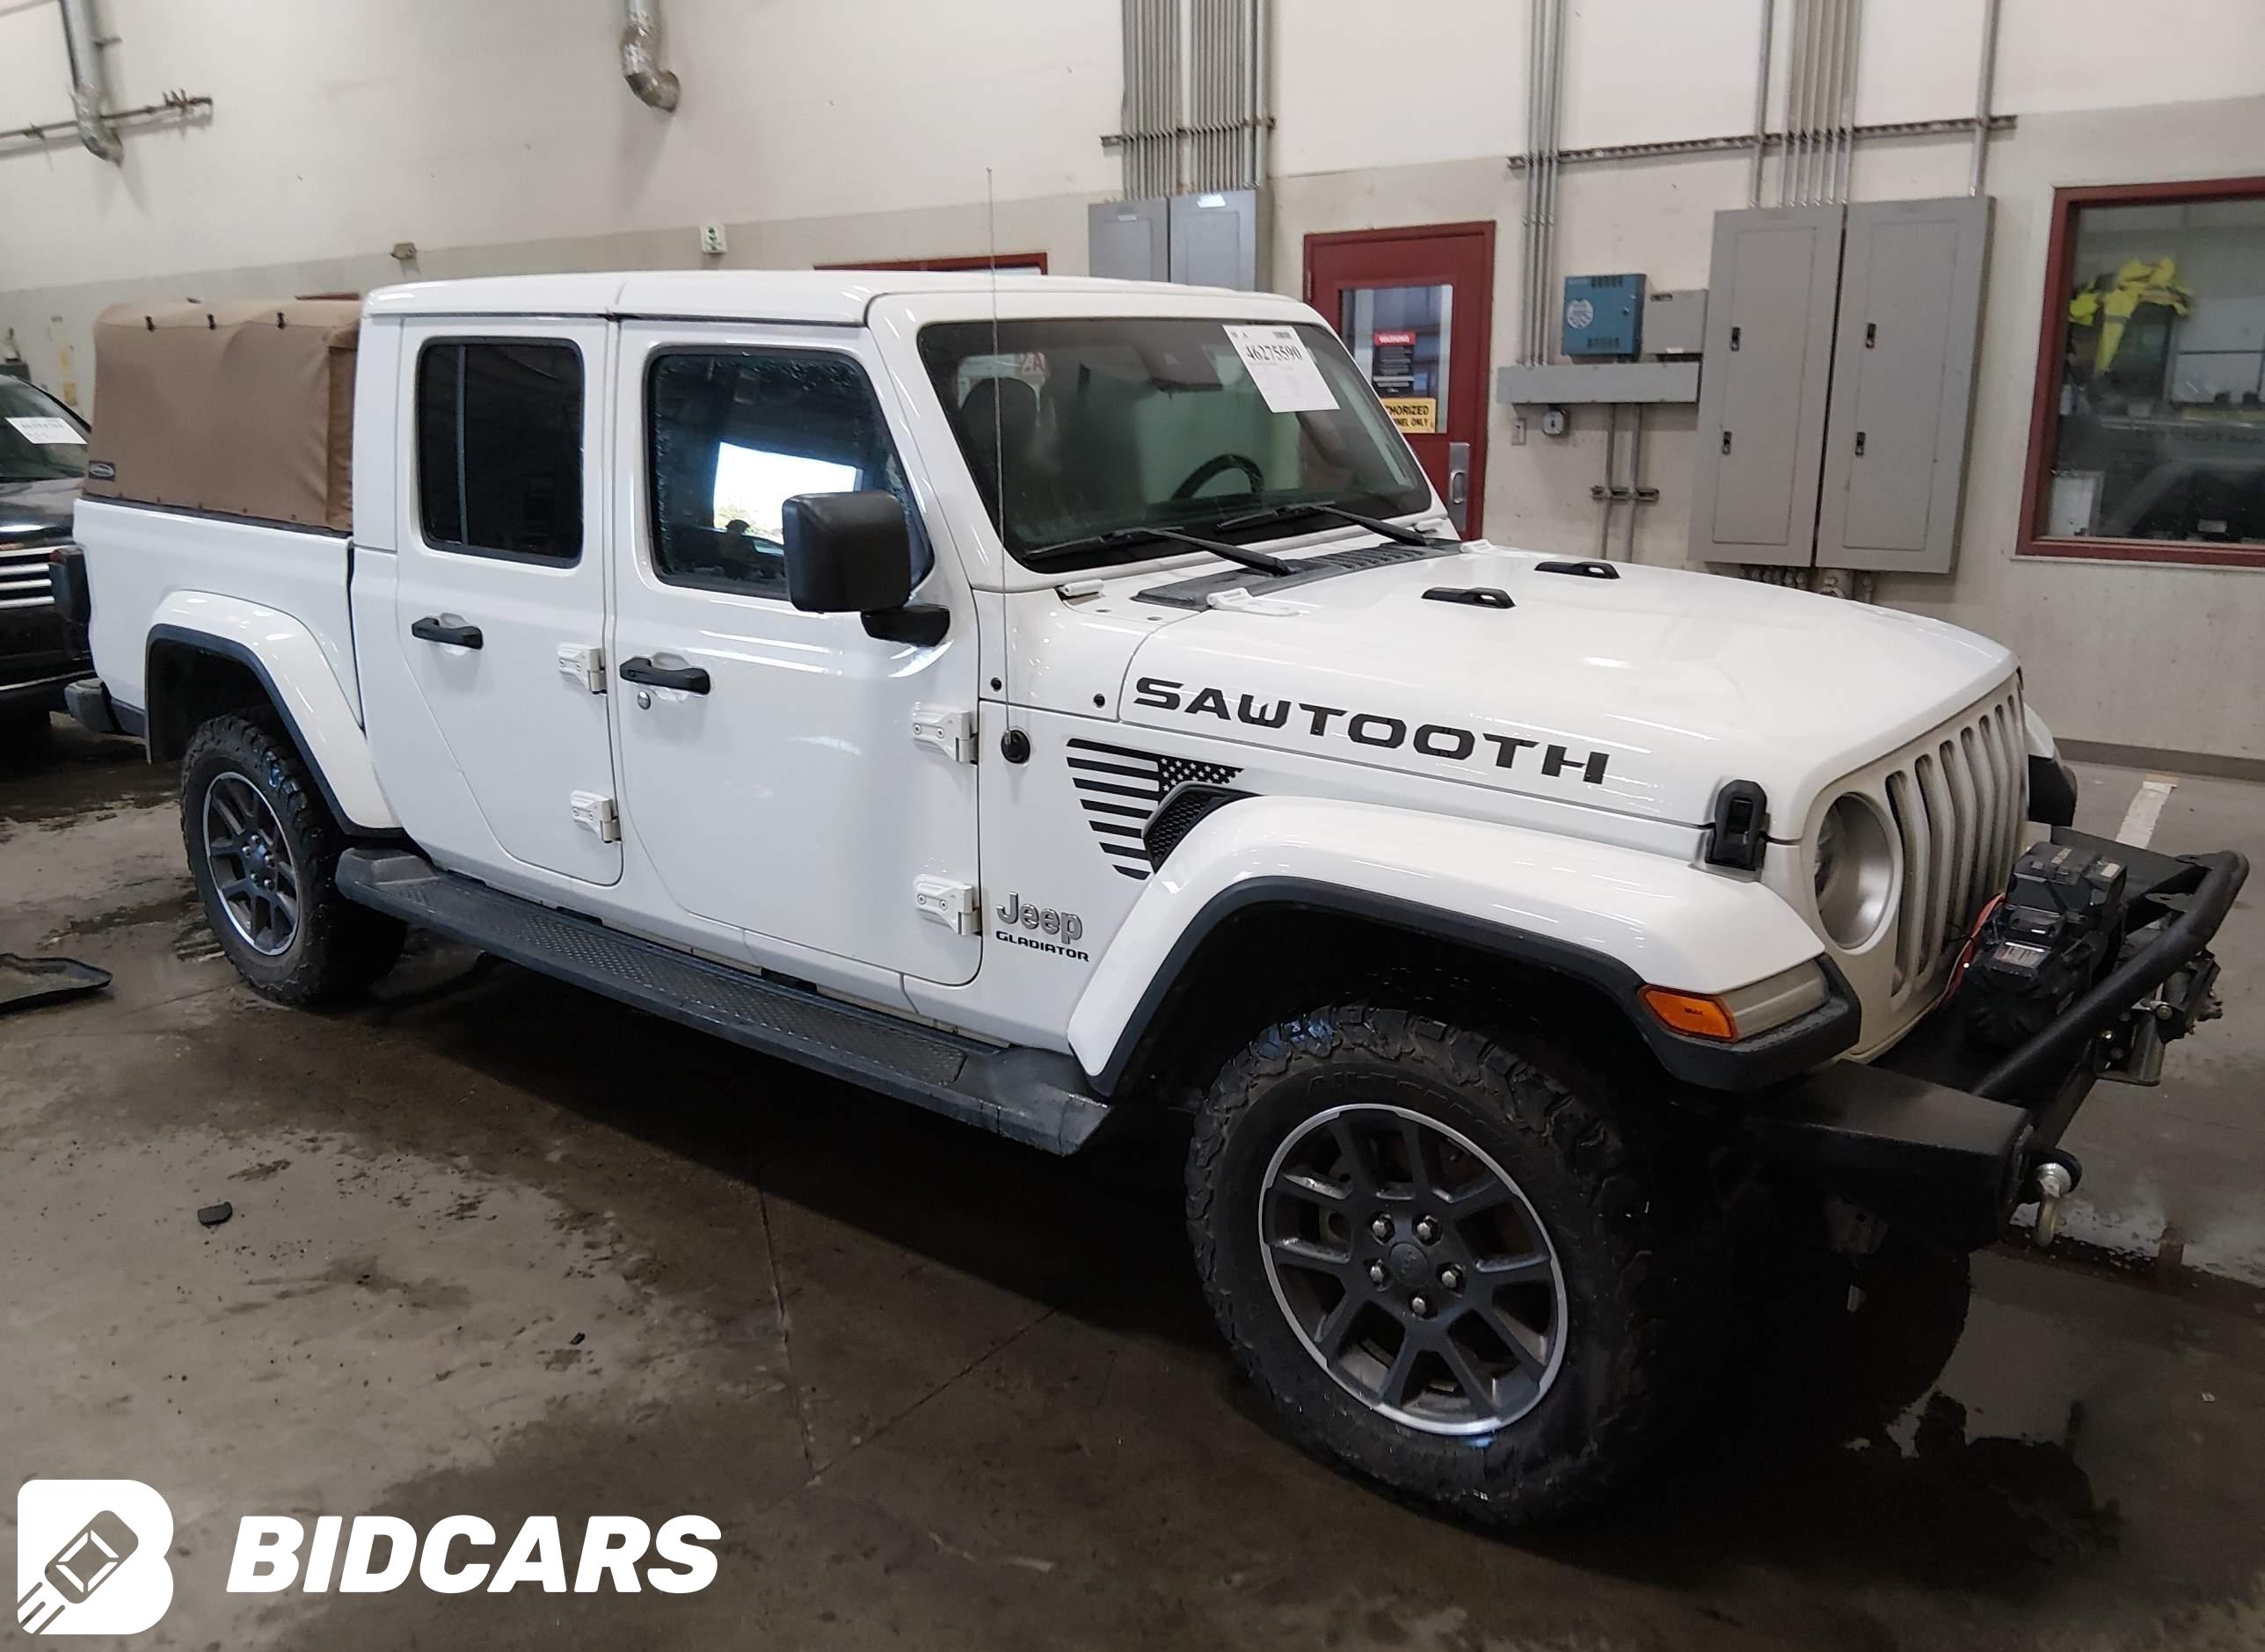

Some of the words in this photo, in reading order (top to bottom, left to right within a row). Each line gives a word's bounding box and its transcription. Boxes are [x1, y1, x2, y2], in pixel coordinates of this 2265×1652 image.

[1133, 676, 1610, 785] SAWTOOTH
[995, 891, 1083, 945] Jeep
[995, 930, 1089, 962] GLADIATOR
